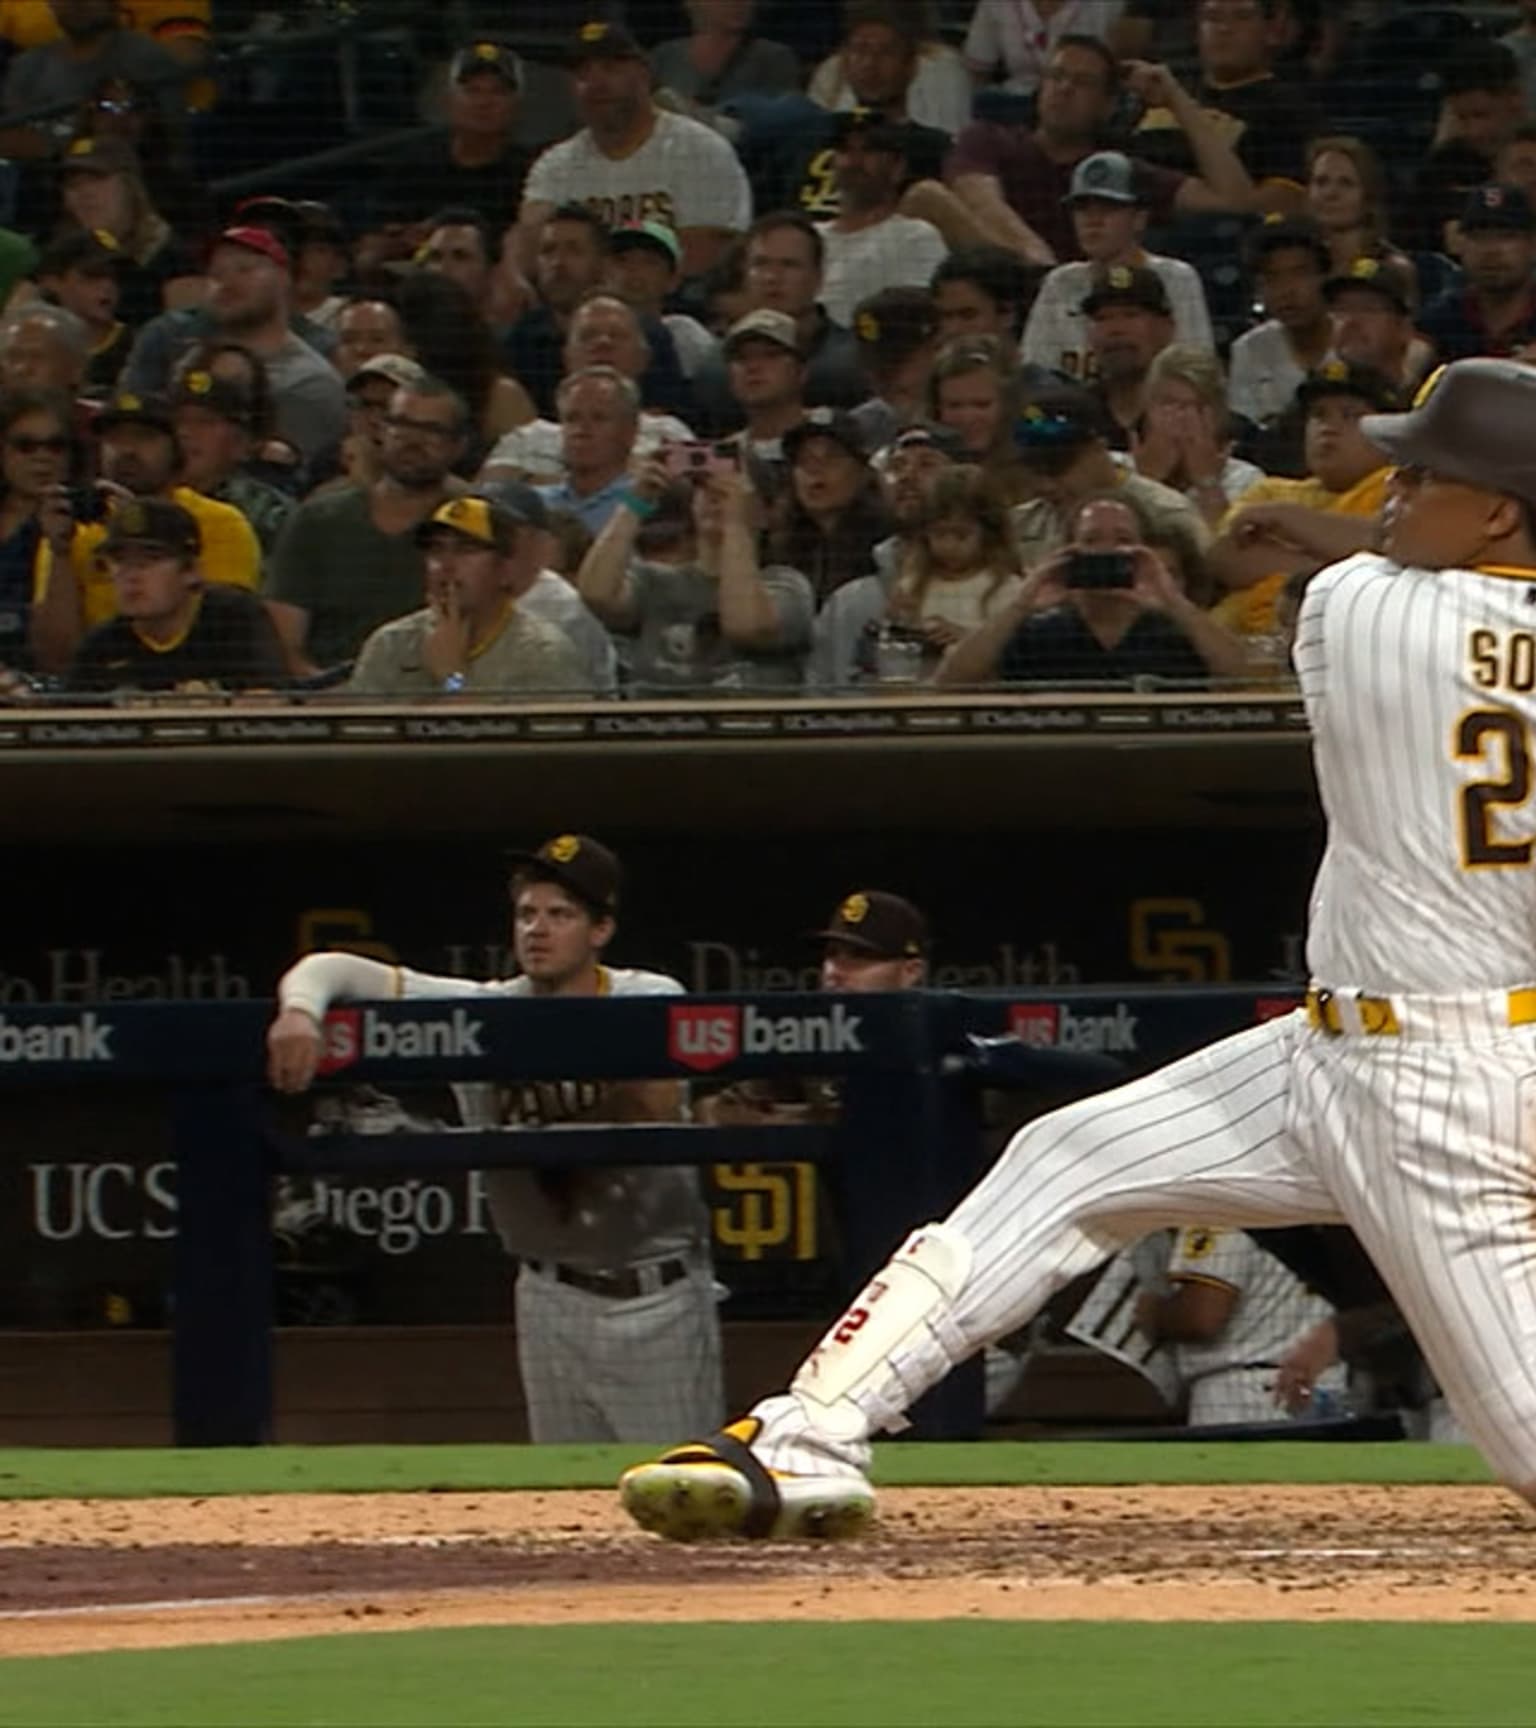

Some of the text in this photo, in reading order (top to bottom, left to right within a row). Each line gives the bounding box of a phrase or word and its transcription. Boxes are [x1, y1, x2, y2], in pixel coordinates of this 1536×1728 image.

[924, 940, 1079, 988] ealth
[0, 1012, 115, 1061] bank
[364, 1009, 485, 1058] bank
[676, 1005, 863, 1054] us bank
[1060, 1004, 1139, 1051] bank
